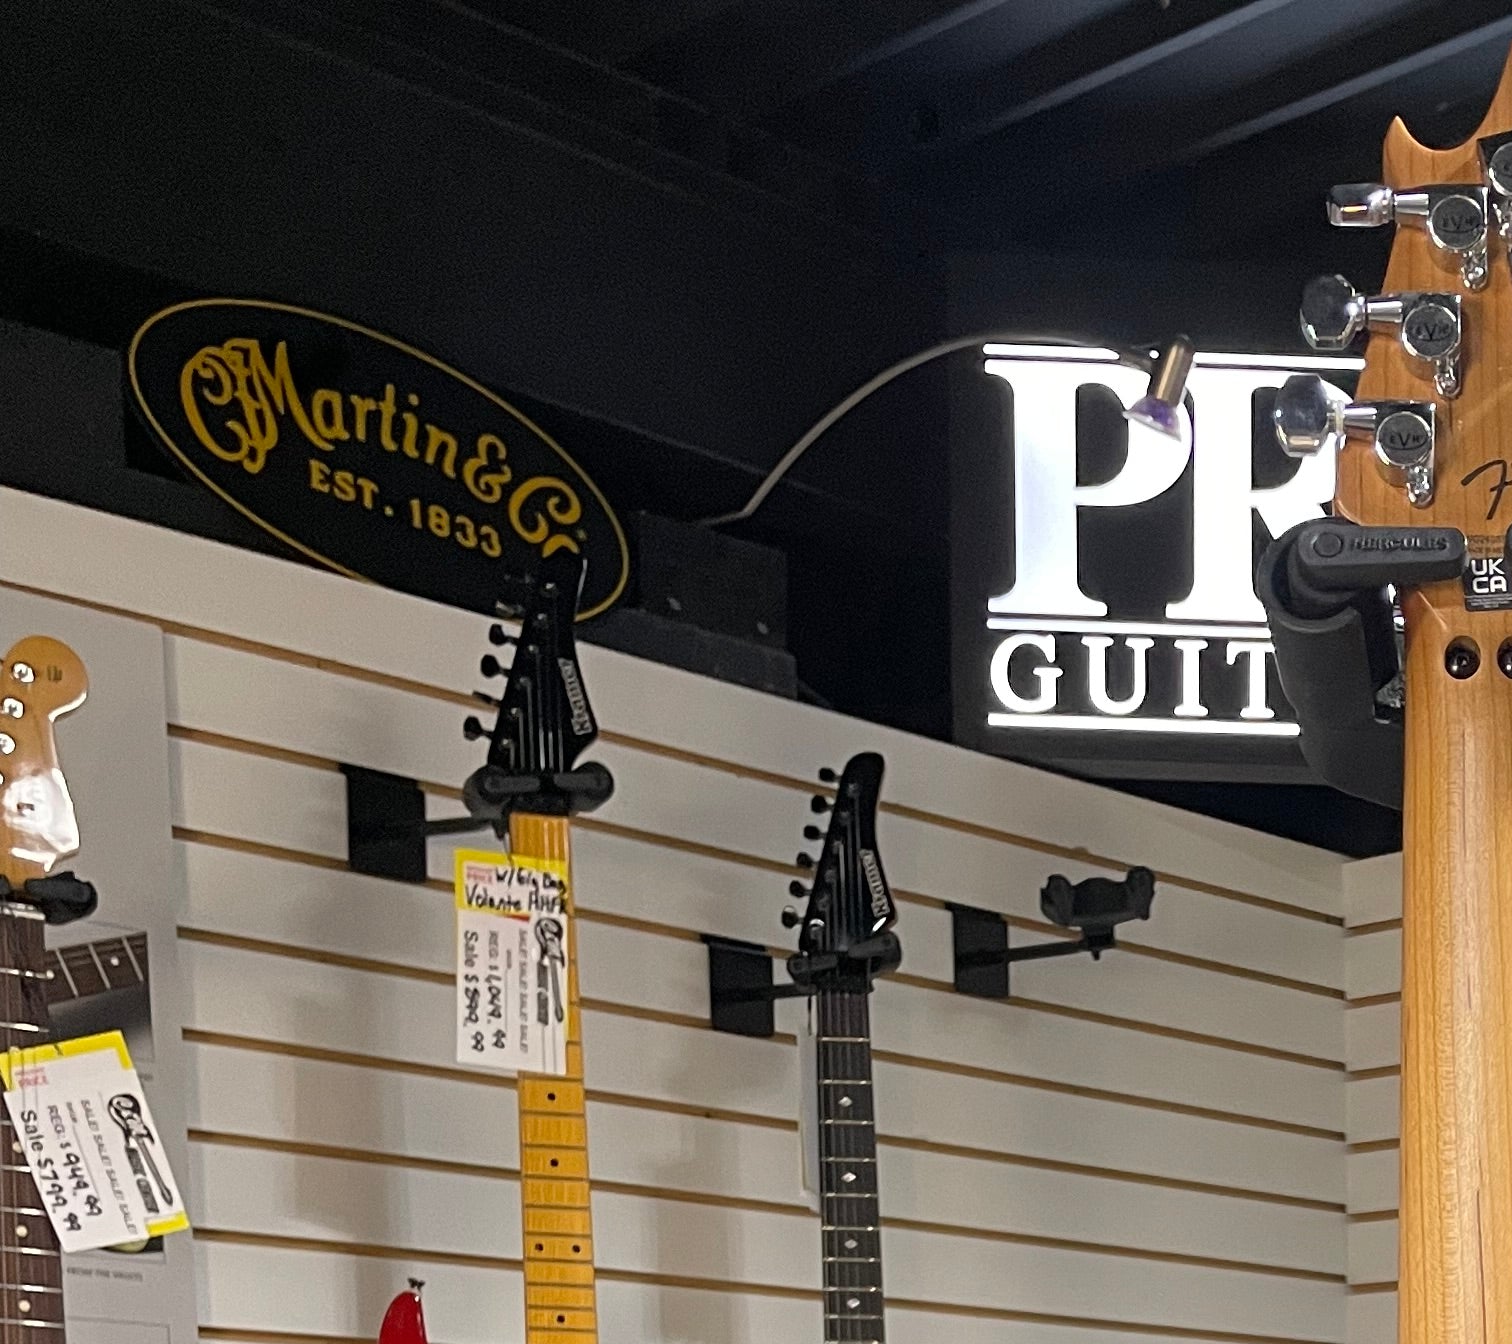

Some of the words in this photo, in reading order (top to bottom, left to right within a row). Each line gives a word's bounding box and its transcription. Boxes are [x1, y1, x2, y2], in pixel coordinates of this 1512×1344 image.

[308, 458, 394, 518] EST.
[409, 498, 501, 558] 1833
[985, 358, 1354, 623] PR
[1470, 557, 1507, 576] UK
[1472, 575, 1508, 594] CA
[990, 632, 1277, 720] GUIT
[463, 930, 479, 967] Sale
[21, 1109, 44, 1154] Sale
